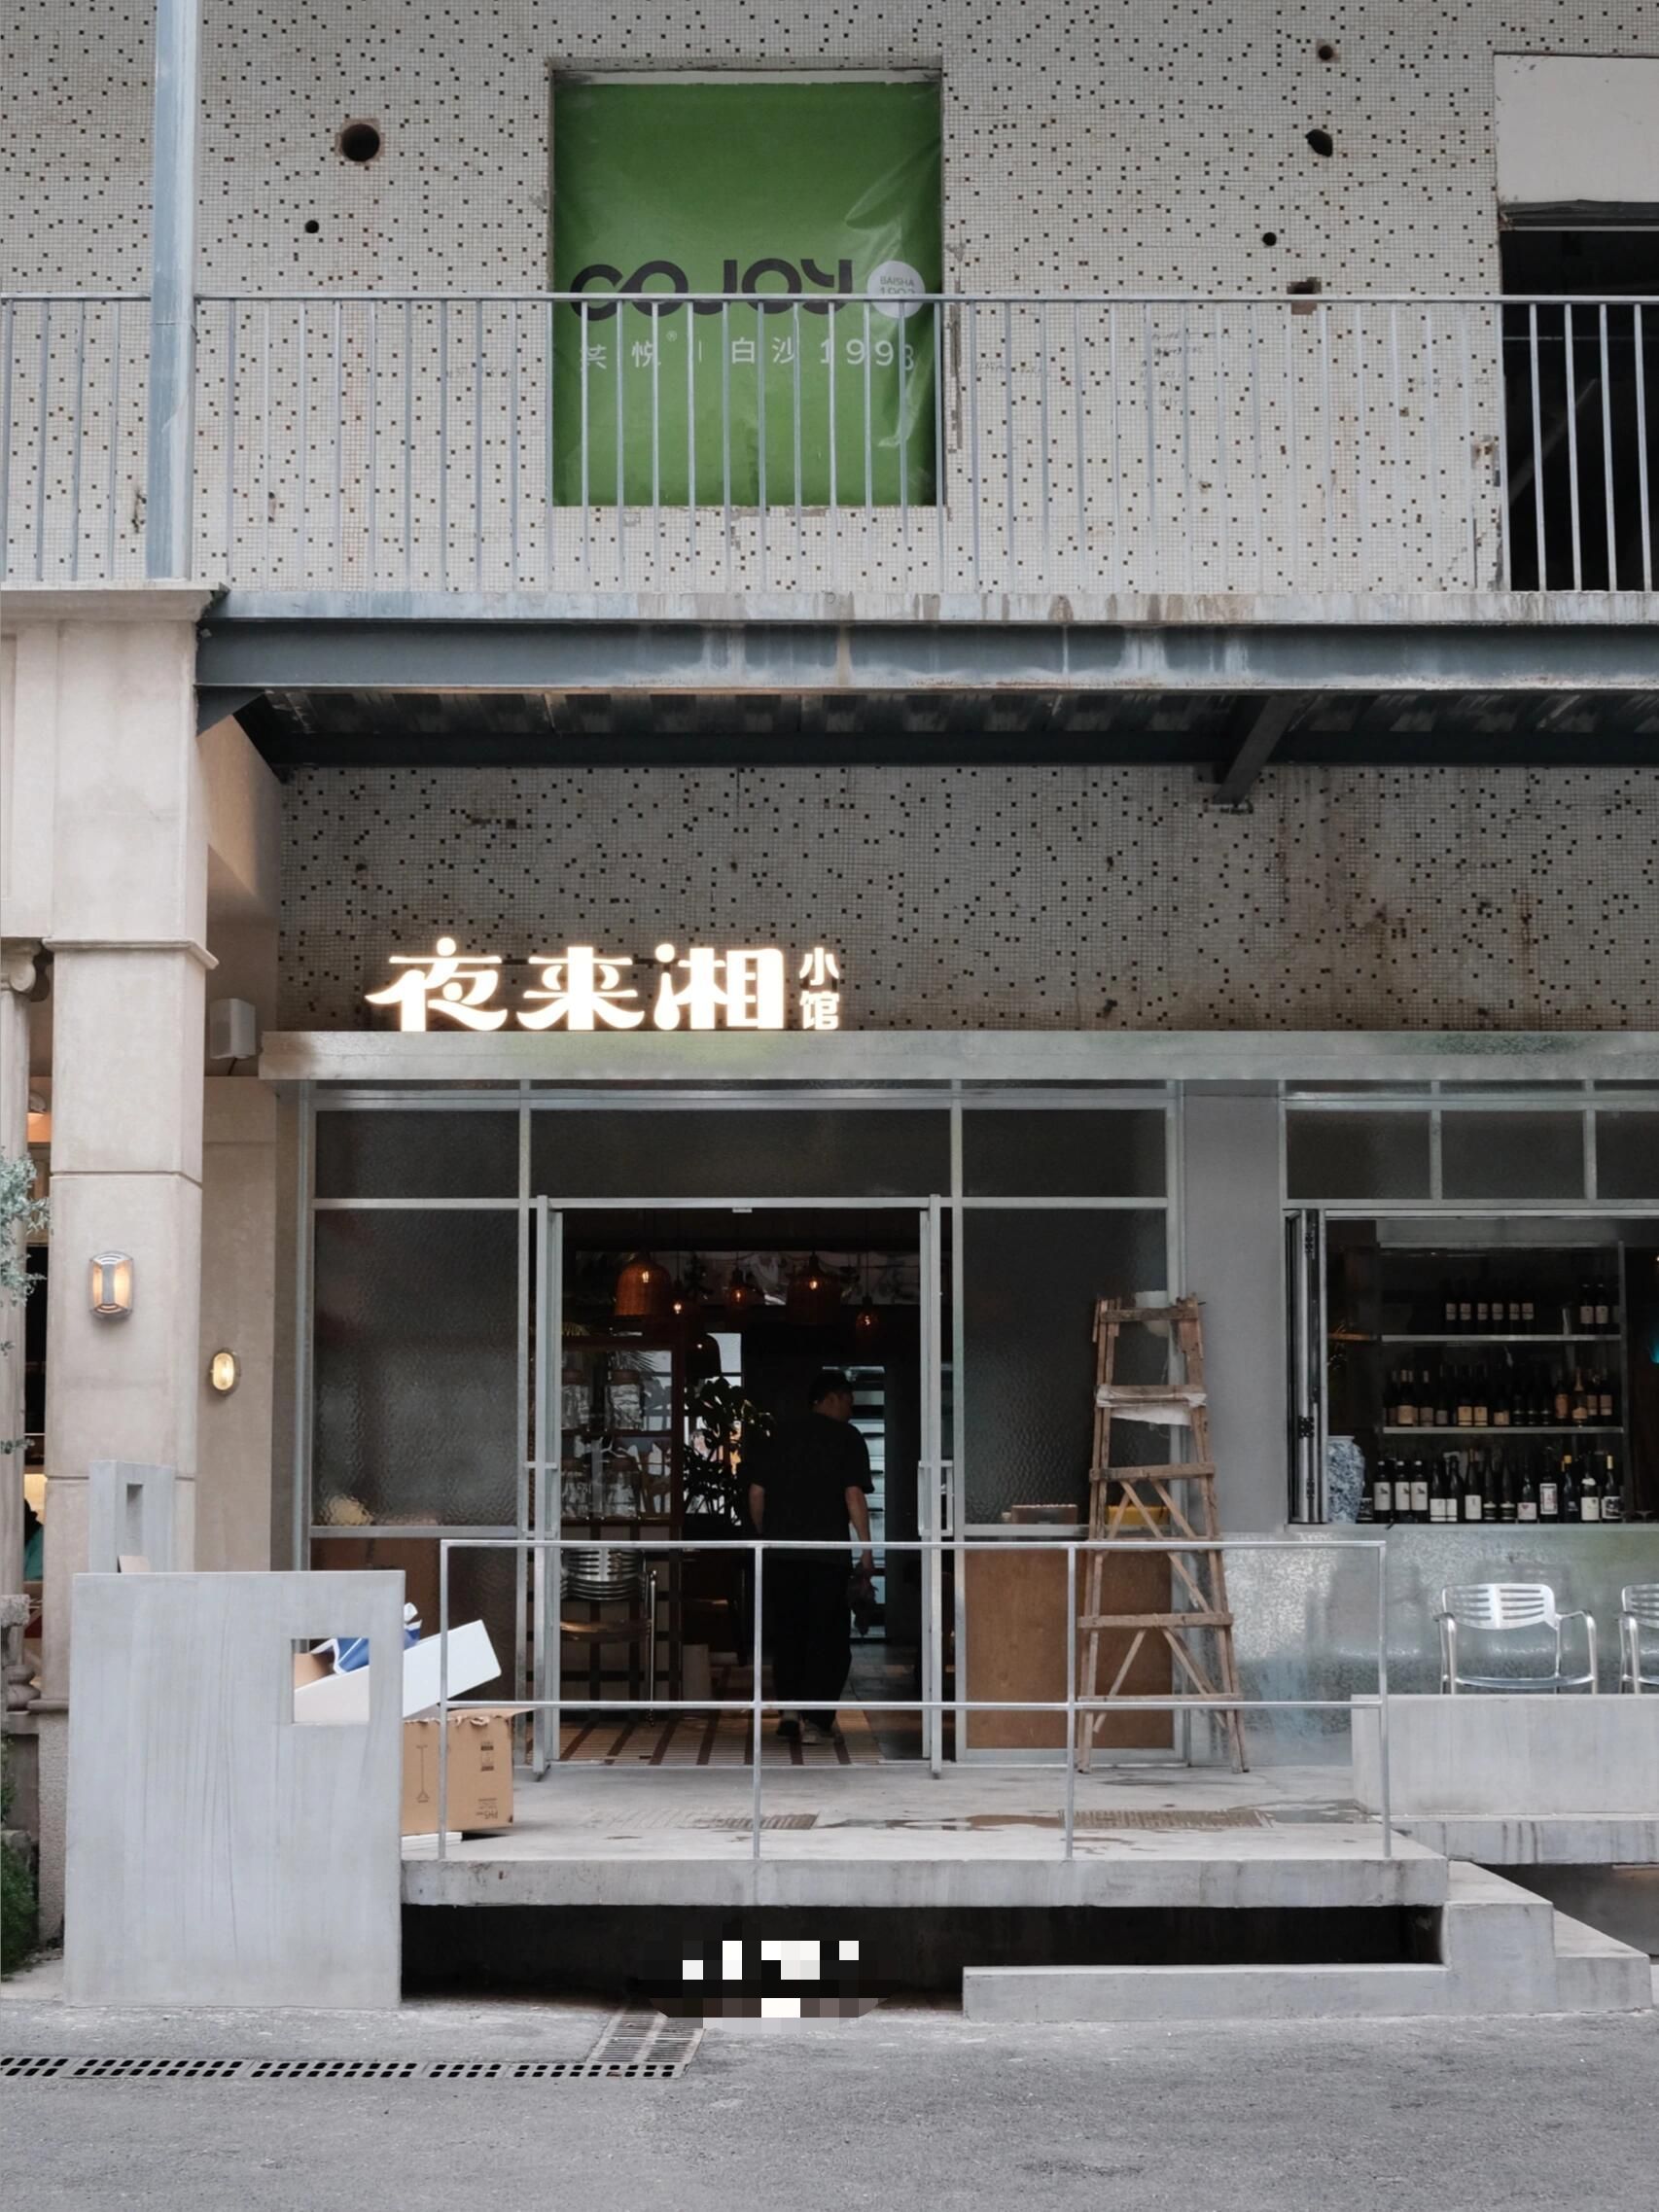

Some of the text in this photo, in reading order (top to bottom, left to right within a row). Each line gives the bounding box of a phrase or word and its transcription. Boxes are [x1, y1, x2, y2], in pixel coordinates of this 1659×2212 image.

[880, 275, 915, 287] BAISHA
[731, 337, 797, 366] 白沙
[365, 936, 839, 1032] 夜来湘 小馆
